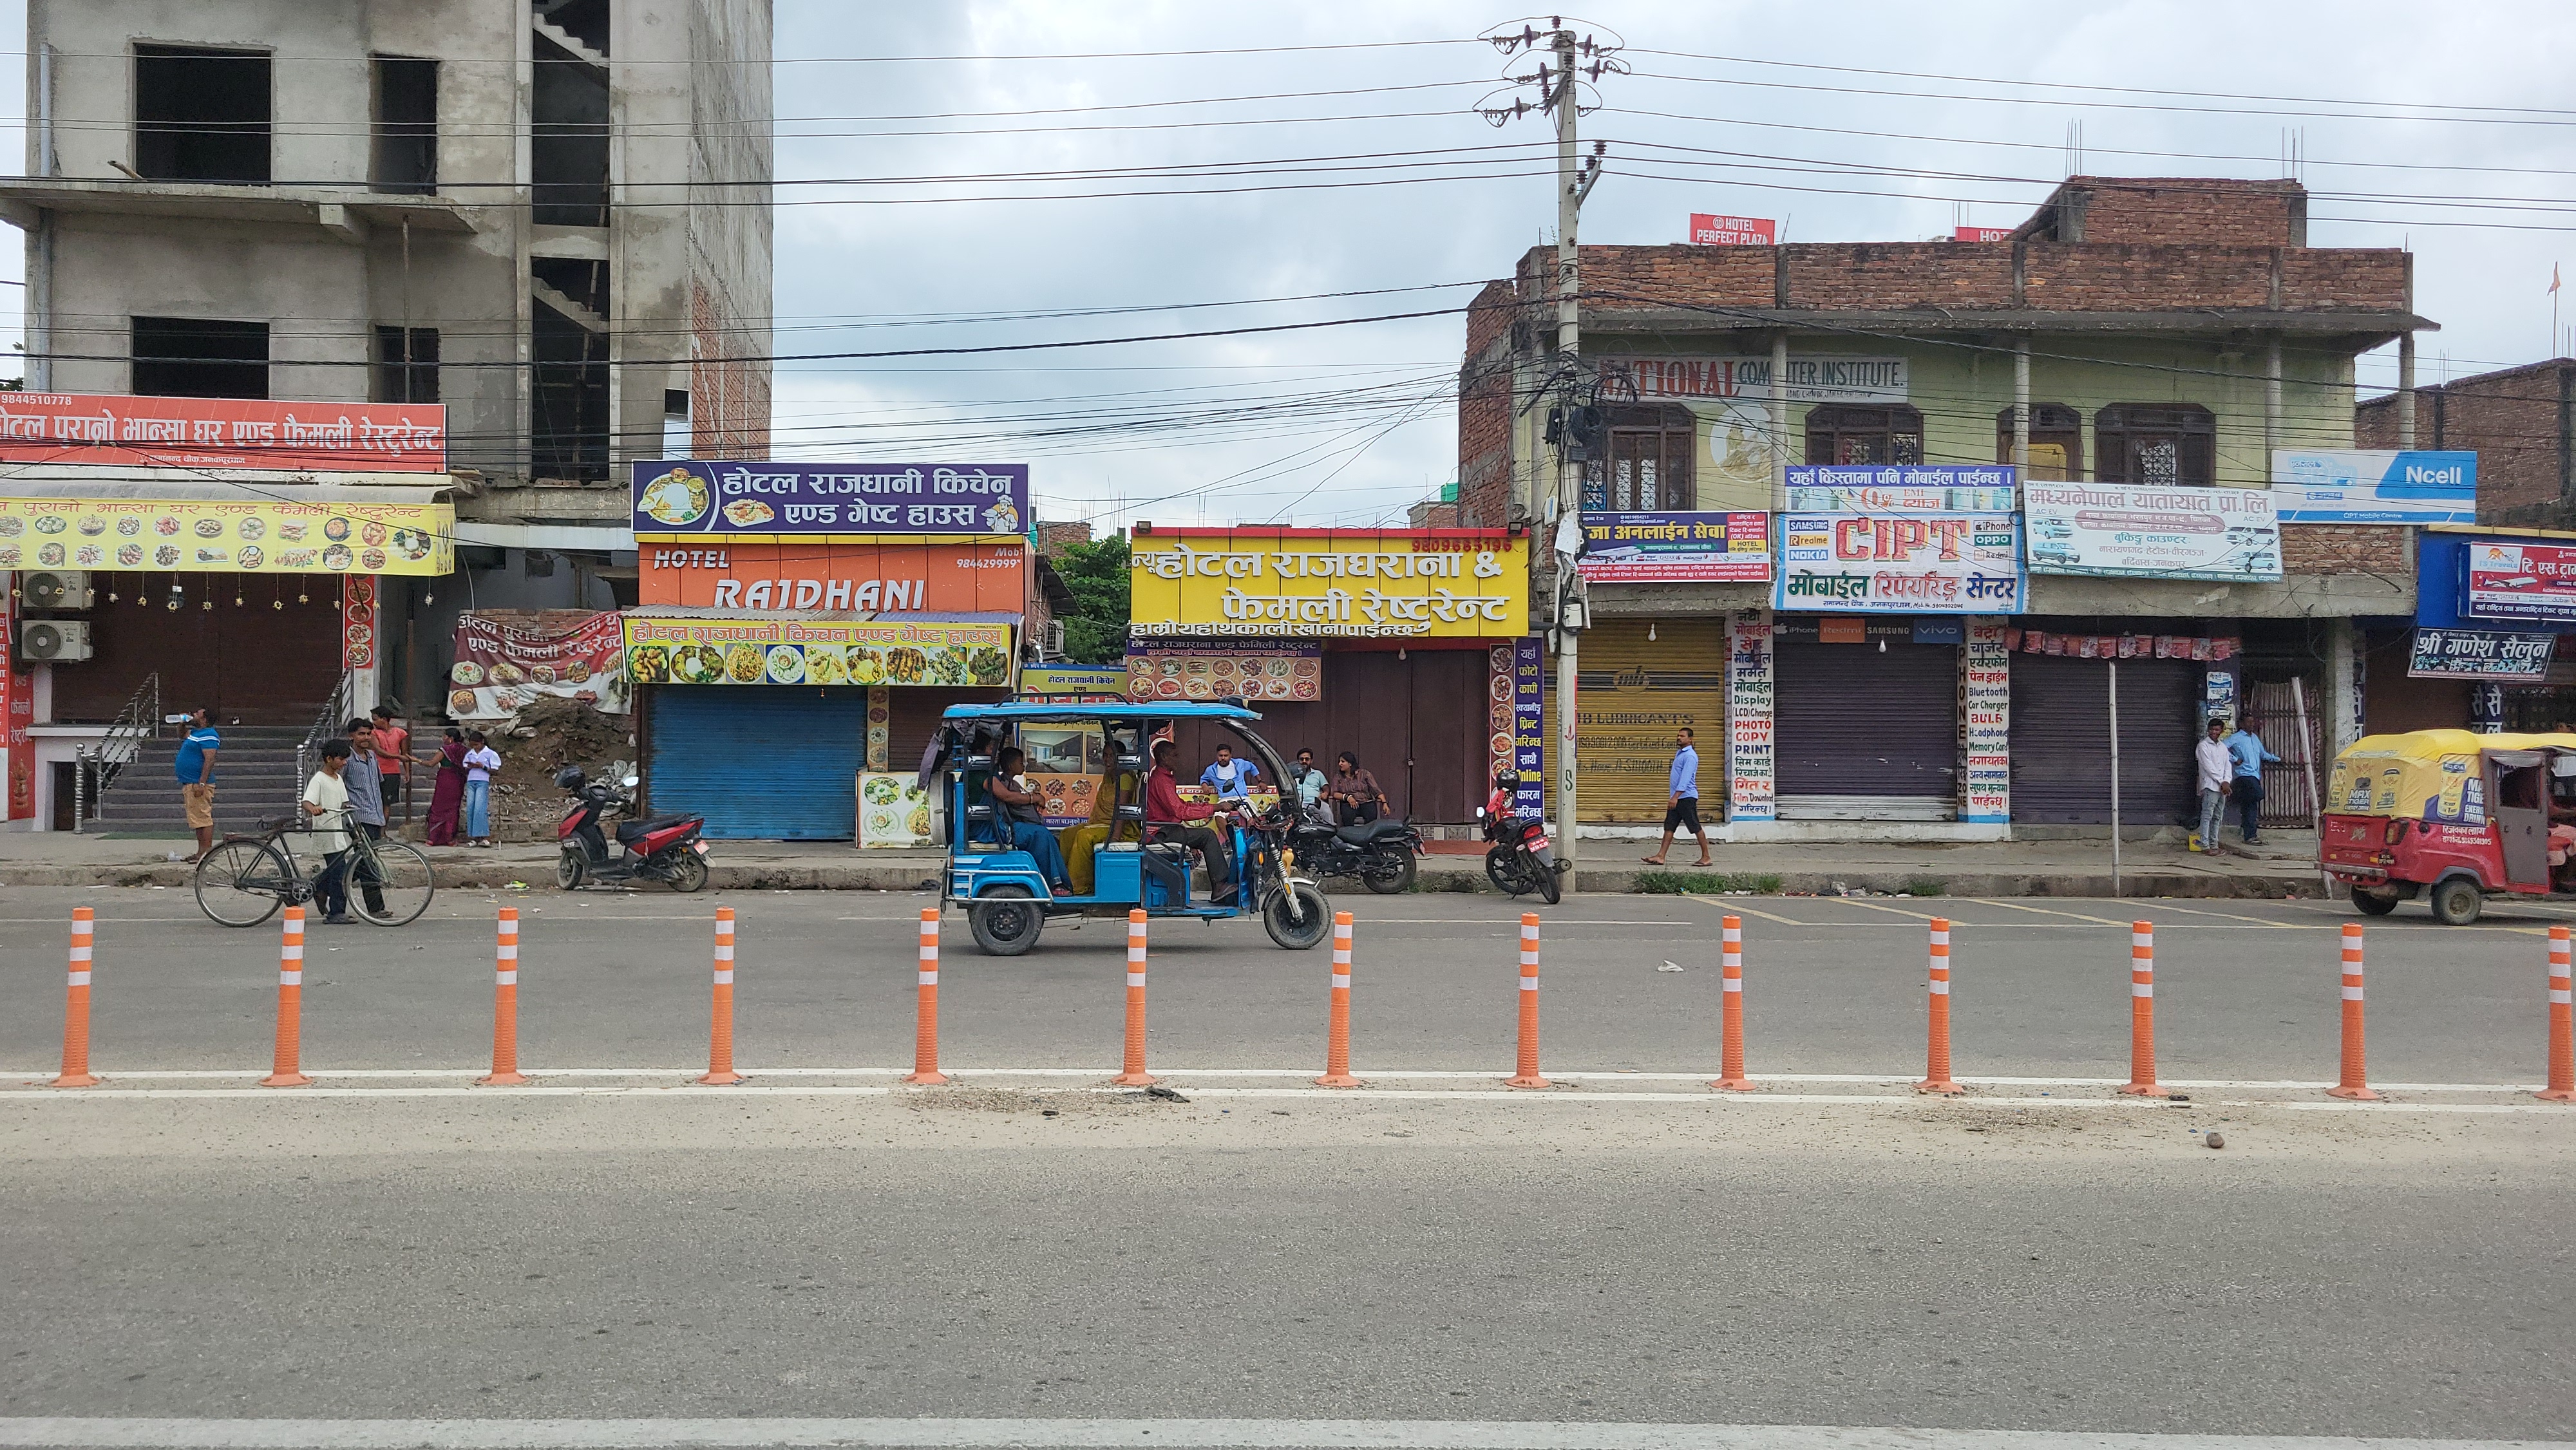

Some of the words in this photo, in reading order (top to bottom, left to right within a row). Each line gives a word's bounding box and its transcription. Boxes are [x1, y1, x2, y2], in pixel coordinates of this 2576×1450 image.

[1725, 218, 1755, 232] HOTEL
[1696, 229, 1738, 245] PERFECT
[1740, 232, 1768, 245] PLAZA
[1979, 230, 2010, 242] HOT
[1739, 361, 1817, 384] COMTER
[1, 395, 72, 406] 9844510778
[0, 406, 47, 439] ोटल
[123, 418, 187, 446] भान्सा
[193, 420, 226, 446] घर
[232, 421, 277, 447] एण्ड
[283, 414, 354, 449] फैमली
[722, 467, 800, 495] होटल
[808, 468, 925, 495] राजधानी
[933, 467, 1014, 495] किचेन
[1789, 468, 1815, 485] यहाँ
[1818, 467, 1873, 485] किस्तामा
[1875, 468, 1901, 484] पनि
[1904, 468, 1955, 485] मोबाईल
[2405, 466, 2461, 484] Ncell
[169, 504, 201, 515] घर
[2131, 493, 2211, 513] यातायात
[783, 504, 840, 525] एण्ड
[847, 498, 900, 526] गेष्ट
[907, 504, 977, 526] हाउस
[1584, 525, 1611, 540] जा
[1614, 520, 1690, 541] अनलाईन
[1692, 521, 1727, 539] सेवा
[1790, 521, 1828, 531] SAMSUNG
[1982, 522, 2011, 531] iPhone
[1799, 536, 1828, 545] realme
[1835, 517, 1970, 562] CIPT
[654, 549, 730, 570] HOTEL
[1155, 543, 1265, 578] होटल
[1271, 552, 1464, 578] राजघराना
[1473, 551, 1504, 578] &
[1985, 551, 2009, 559] Redmi
[2559, 563, 2576, 579] ट्रा
[1787, 569, 1871, 599] मोबाईल
[1965, 571, 2017, 599] सेन्टर
[714, 579, 925, 611] RAJDHANI
[1220, 587, 1354, 621] फेमली
[630, 621, 691, 643] होटल
[692, 623, 782, 645] राजधानी
[853, 627, 898, 645] एण्ड
[900, 624, 945, 644] गेष्ट
[945, 629, 1003, 646] हाउस
[1735, 622, 1772, 636] मोबाईल
[1918, 626, 1958, 634] vivo
[2416, 632, 2443, 655] श्री
[2445, 634, 2497, 658] गणेश
[1520, 646, 1536, 659] यहाँ
[1734, 650, 1772, 664] मोबल
[1519, 664, 1538, 676] फोटो
[1969, 670, 1985, 682] पेन
[1048, 675, 1066, 684] होटल
[1734, 679, 1772, 693] मोबाईल
[1519, 682, 1538, 694] कापी
[1969, 686, 2008, 697] Bluetooth
[1734, 695, 1772, 707] Display
[1968, 701, 1979, 710] Car
[1980, 700, 2008, 712] Charger
[1732, 707, 1750, 718] (LCD)
[1750, 707, 1773, 720] Change
[1519, 717, 1538, 730] प्रिन्ट
[1734, 720, 1772, 730] PHOTO
[1515, 736, 1542, 748] गरिन्छ
[1736, 732, 1768, 742] COPY
[1735, 744, 1772, 755] PRINT
[1969, 741, 1994, 753] Memory
[1995, 741, 2008, 751] Card
[1520, 752, 1537, 765] साथै
[1735, 756, 1751, 766] सिम
[1753, 757, 1772, 766] कार्ड
[2467, 778, 2483, 792] MA
[1517, 789, 1540, 800] फारम
[1733, 793, 1748, 802] Film
[2349, 789, 2372, 799] MAX
[2467, 791, 2484, 804] TIGE
[1515, 807, 1542, 818] भरिन्छ
[2465, 804, 2485, 813] ENERG
